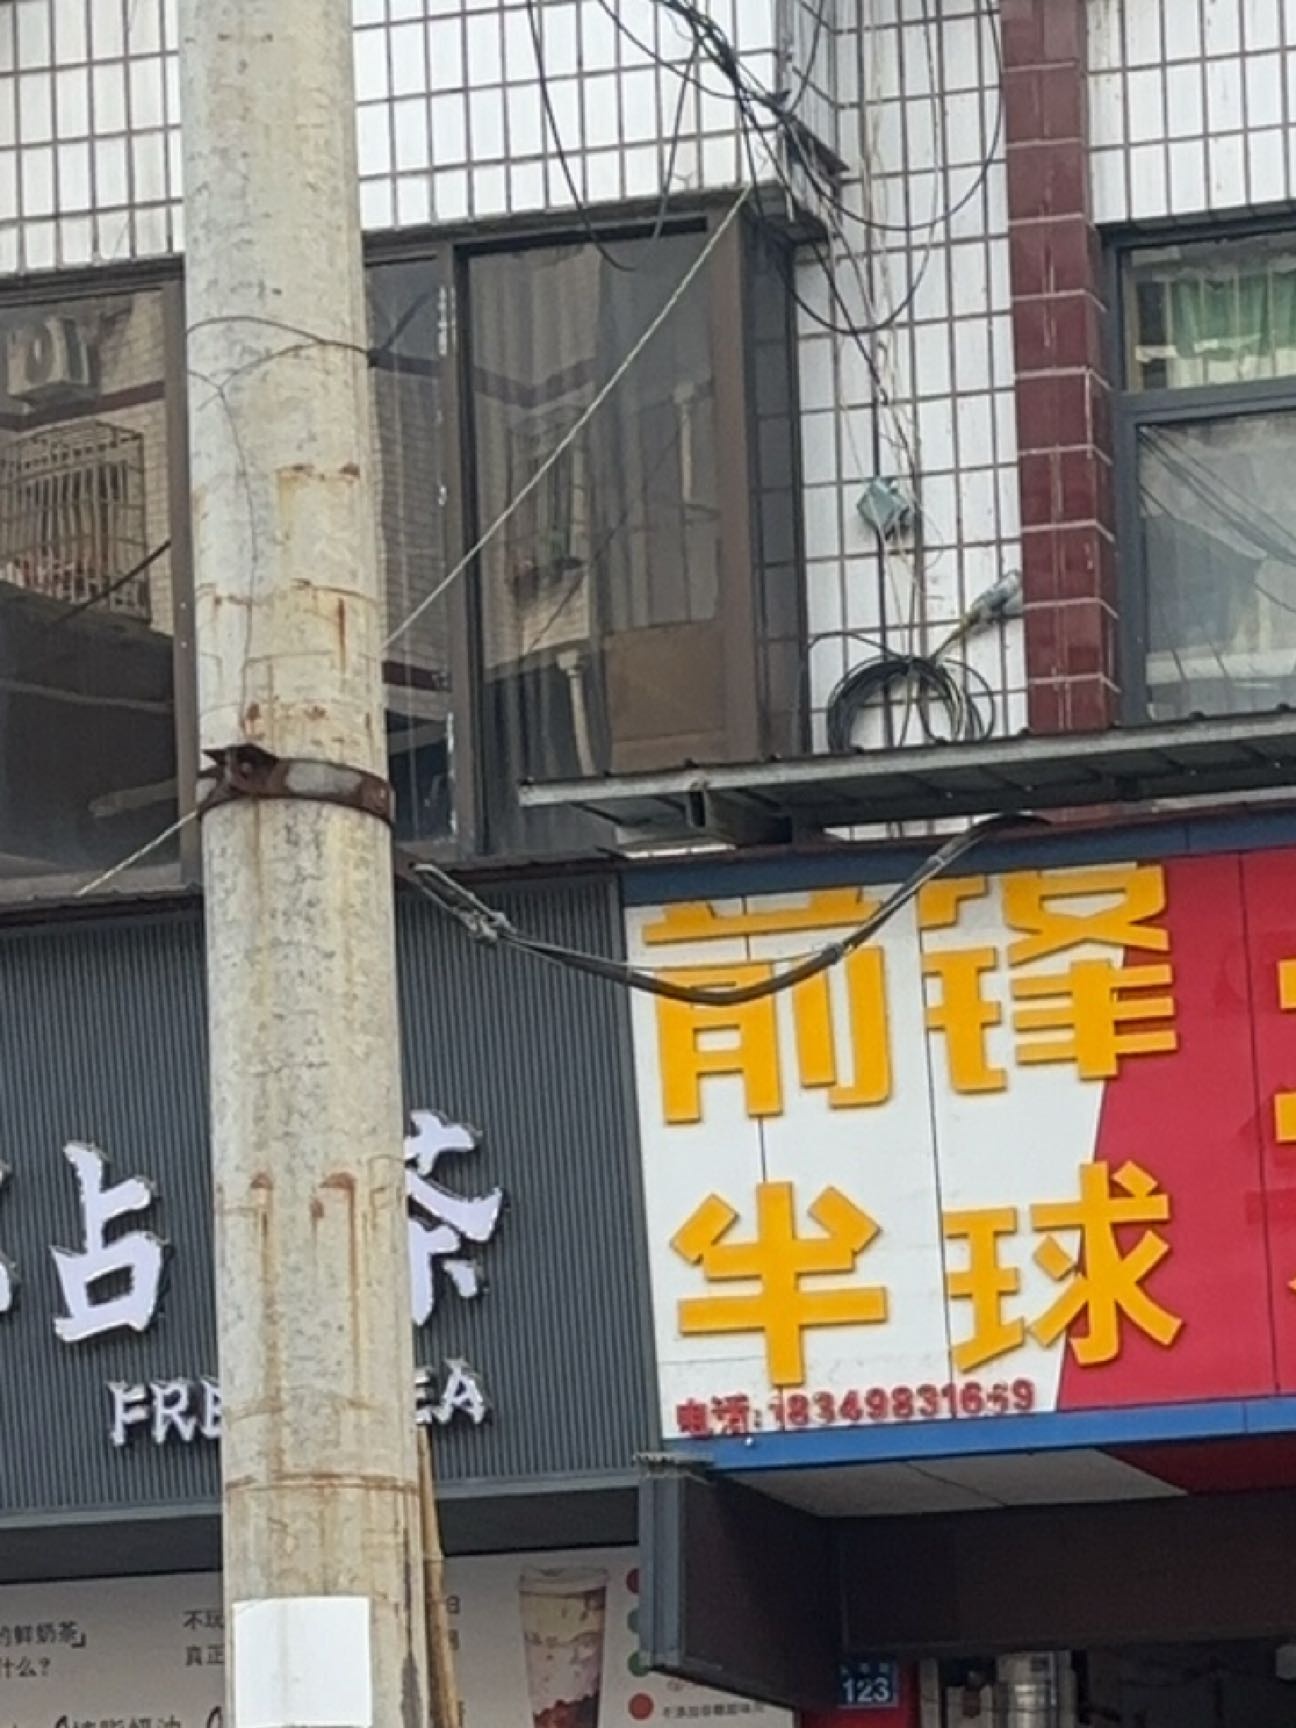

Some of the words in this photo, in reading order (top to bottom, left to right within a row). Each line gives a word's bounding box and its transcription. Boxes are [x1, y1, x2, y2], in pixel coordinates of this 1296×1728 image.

[642, 864, 1178, 1124] 前锋
[669, 1160, 1183, 1388] 半球
[842, 1677, 889, 1703] 123
